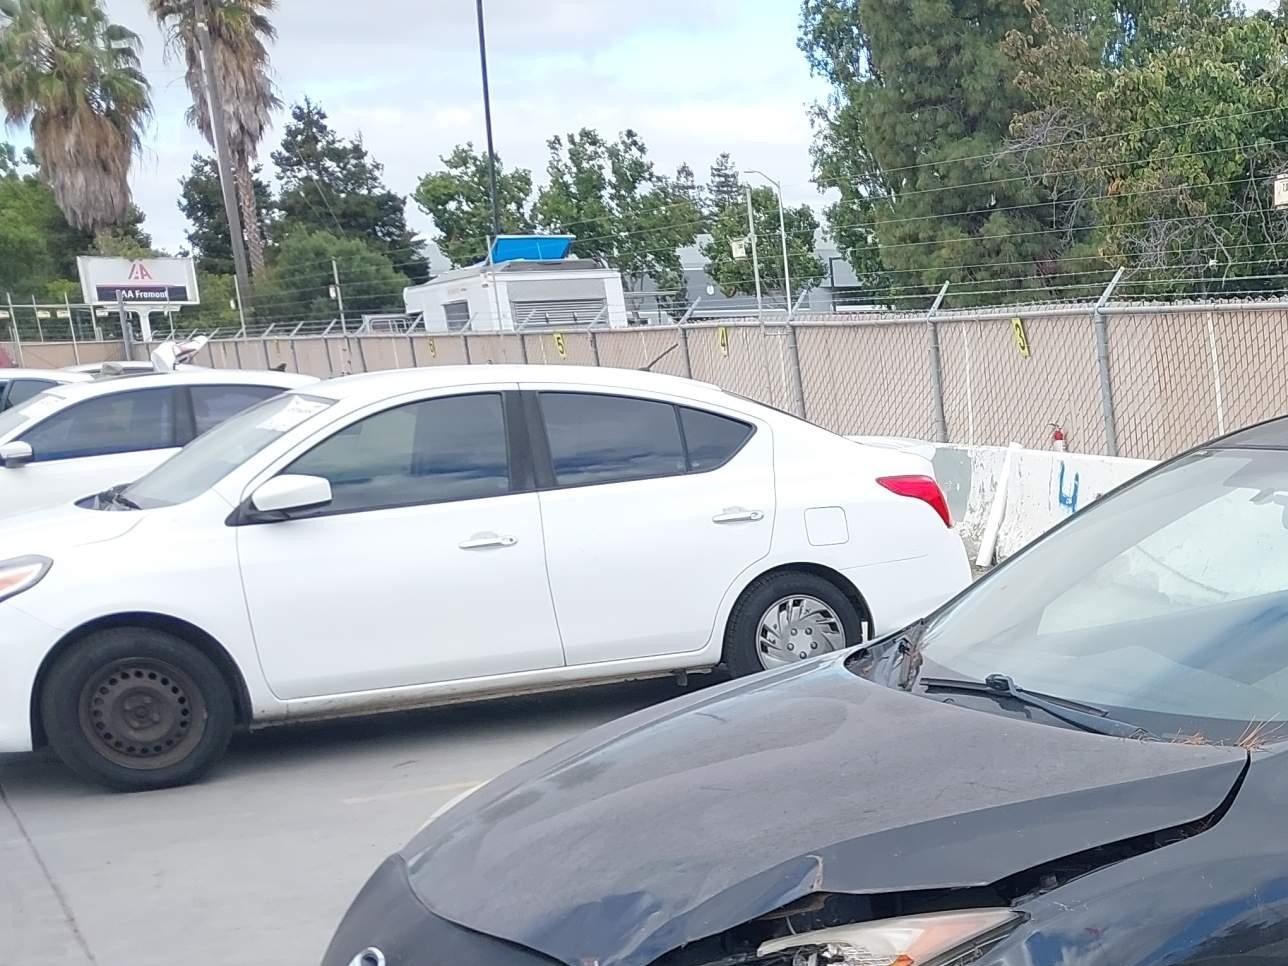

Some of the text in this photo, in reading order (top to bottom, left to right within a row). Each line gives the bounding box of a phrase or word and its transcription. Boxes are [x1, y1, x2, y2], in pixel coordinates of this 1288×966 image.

[556, 336, 564, 354] 5
[1015, 323, 1025, 351] 3
[1059, 461, 1079, 512] 4
